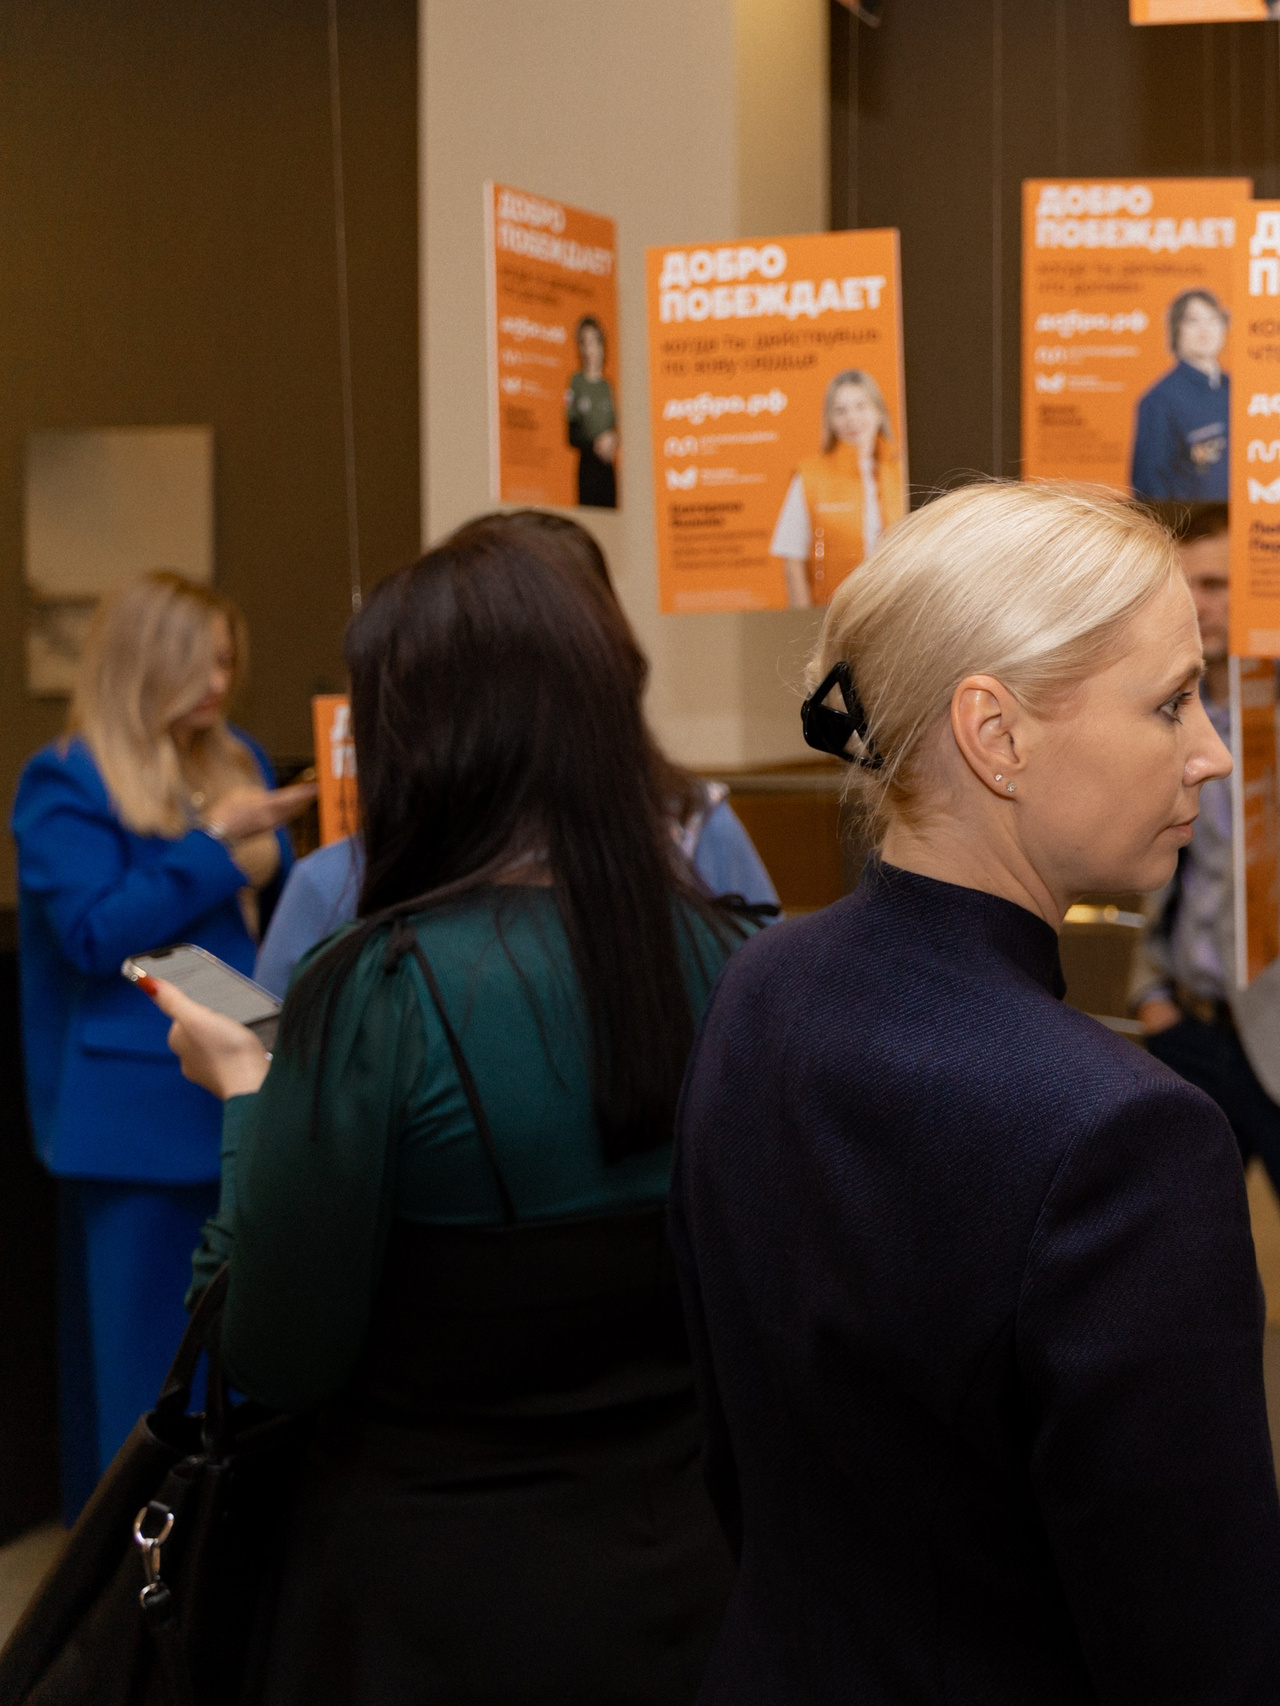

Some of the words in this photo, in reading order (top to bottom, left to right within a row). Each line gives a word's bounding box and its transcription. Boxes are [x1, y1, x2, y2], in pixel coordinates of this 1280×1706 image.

[498, 189, 566, 234] ДОБРО
[1036, 186, 1154, 217] ДОБРО
[498, 223, 614, 276] ПОБЕЖДАЕТ
[1035, 218, 1235, 253] ПОБЕЖДАЕТ
[660, 243, 787, 291] ДОБРО
[660, 274, 887, 323] ПОБЕЖДАЕТ
[662, 387, 788, 425] добро.рф
